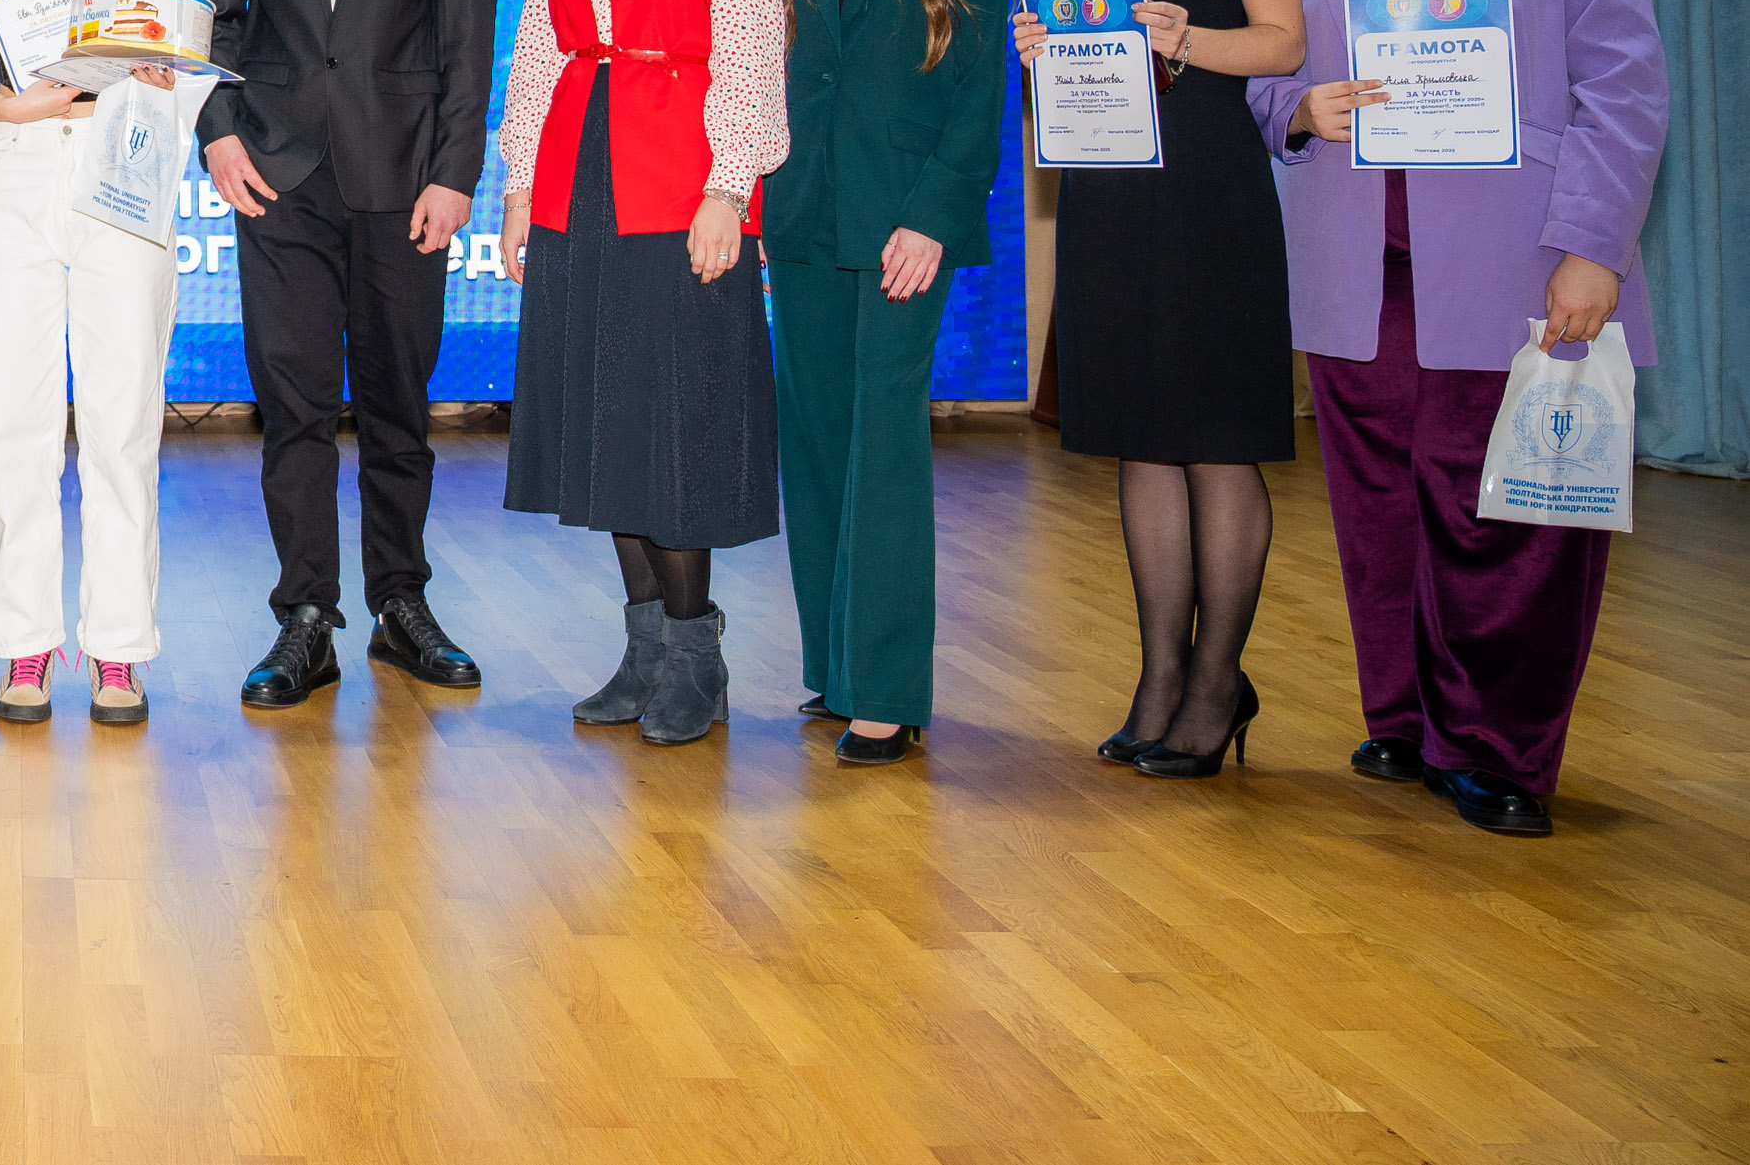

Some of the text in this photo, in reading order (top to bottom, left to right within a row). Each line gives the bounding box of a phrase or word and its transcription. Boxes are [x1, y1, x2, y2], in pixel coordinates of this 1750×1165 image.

[40, 10, 70, 24] ПЕРЕМО
[1049, 43, 1127, 57] ГРАМОТА
[1377, 39, 1486, 56] ГРАМОТА
[1383, 76, 1410, 85] Алла
[1503, 478, 1620, 494] НАЦІОНАЛЬНИЙ УНІВЕРСИТЕТ
[1506, 498, 1528, 506] ІМЕНІ
[1565, 495, 1616, 503] ПОЛІТЕХНІКА
